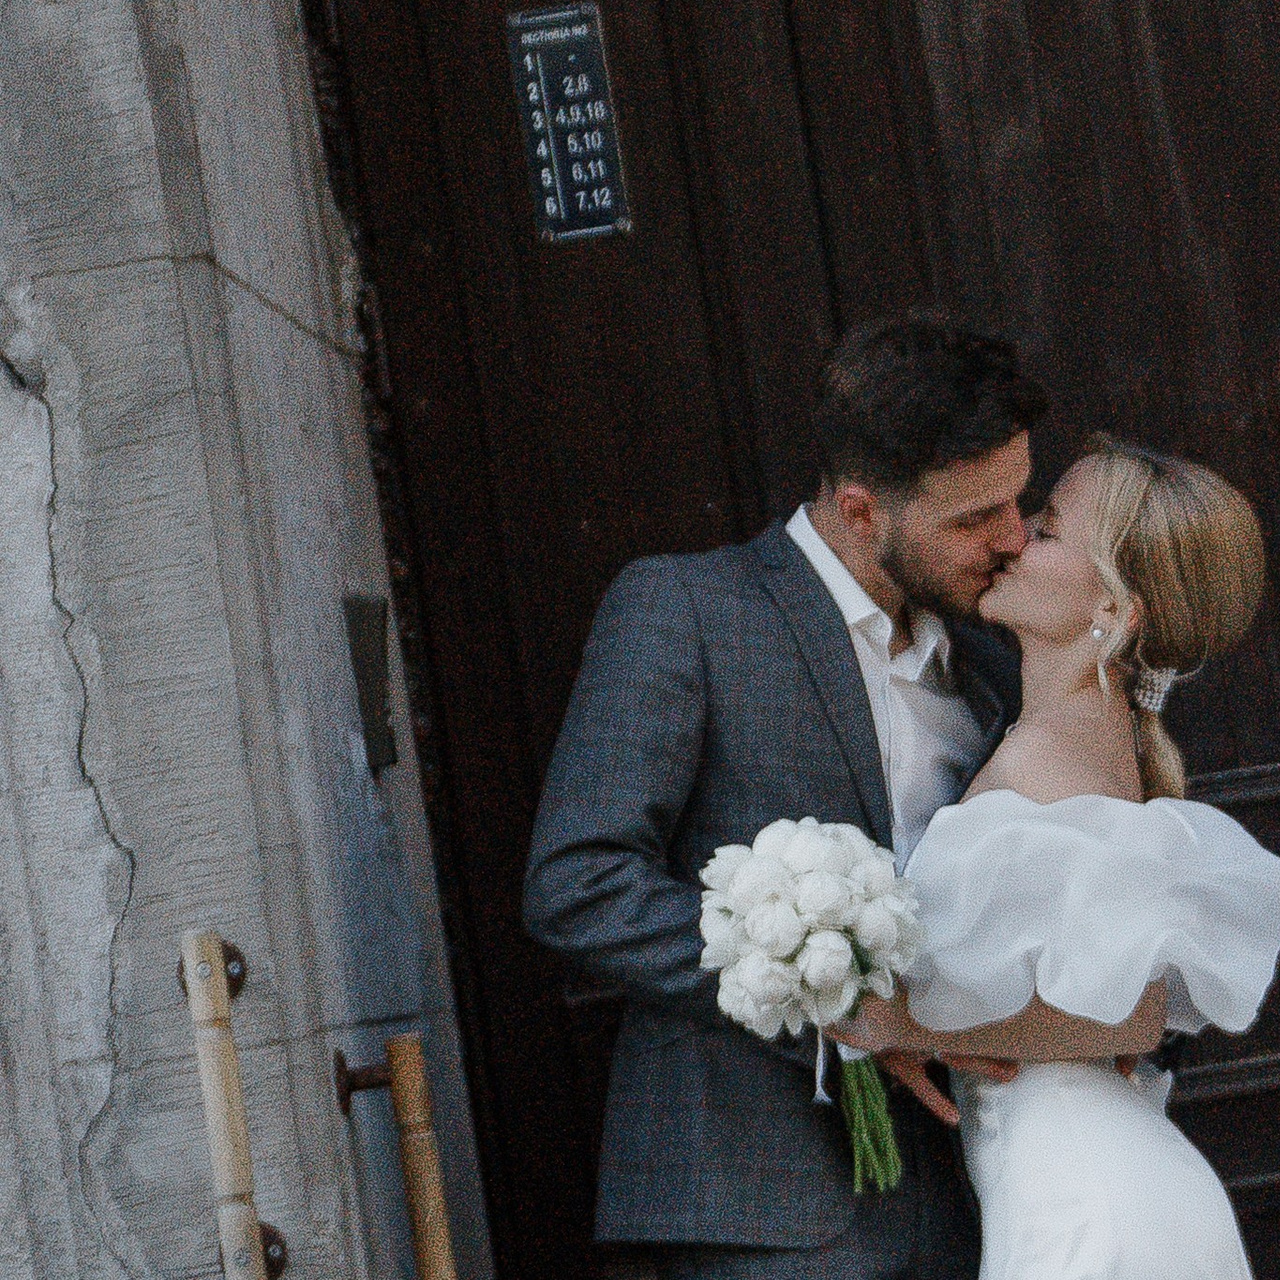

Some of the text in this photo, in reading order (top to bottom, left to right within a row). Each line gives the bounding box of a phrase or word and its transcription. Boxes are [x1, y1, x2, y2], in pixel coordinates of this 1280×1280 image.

[523, 53, 534, 72] 1
[527, 82, 539, 103] 2
[532, 110, 544, 131] 3
[537, 139, 548, 159] 4
[541, 167, 553, 188] 5
[545, 186, 612, 217] 6 7,12
